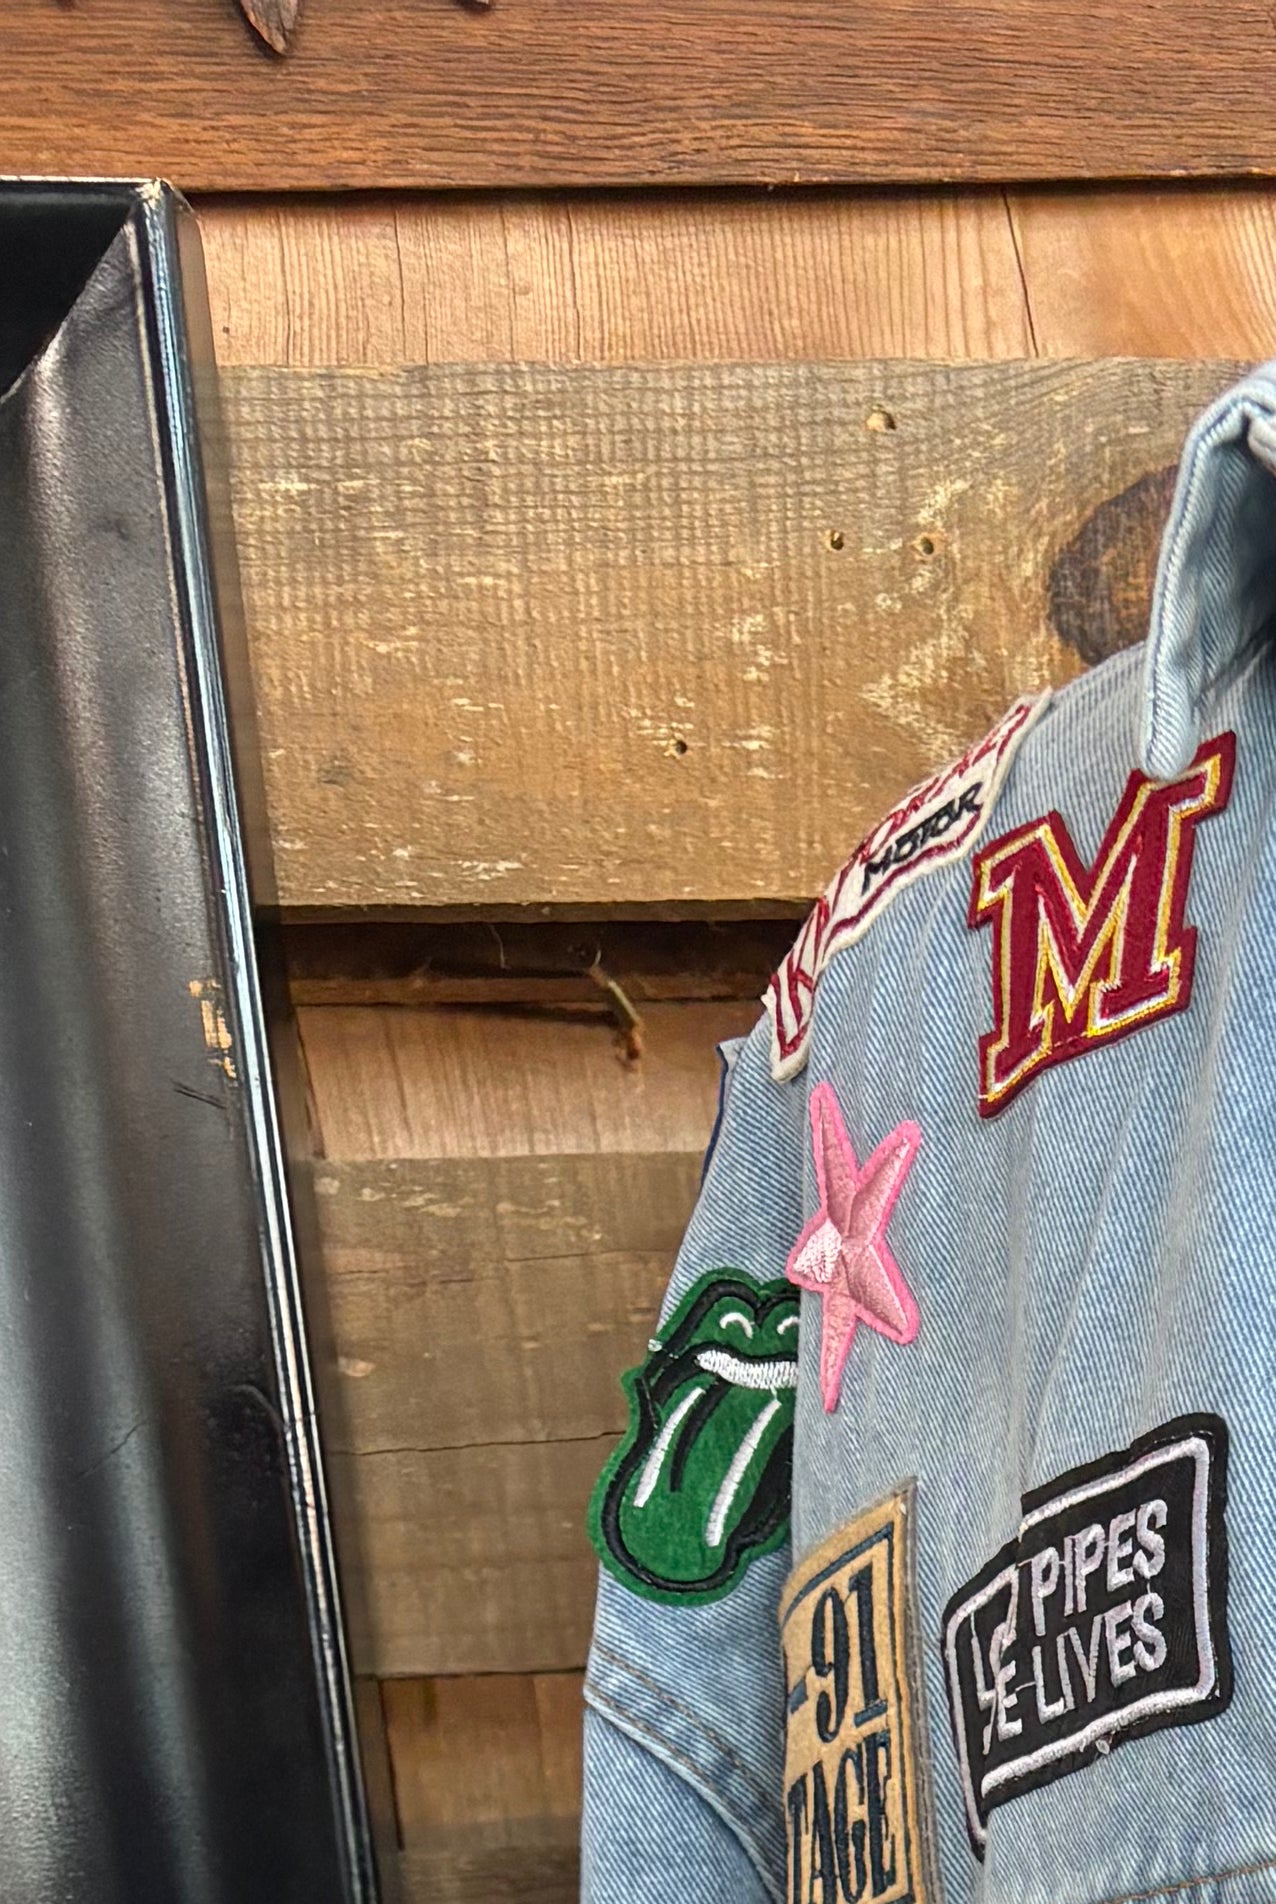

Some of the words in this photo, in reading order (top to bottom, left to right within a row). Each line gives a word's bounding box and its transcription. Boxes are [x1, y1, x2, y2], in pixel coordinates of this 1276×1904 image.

[861, 781, 984, 896] MOTOR
[970, 738, 1230, 1112] M
[1030, 1499, 1168, 1636] PIPES
[1031, 1591, 1168, 1717] LIVES
